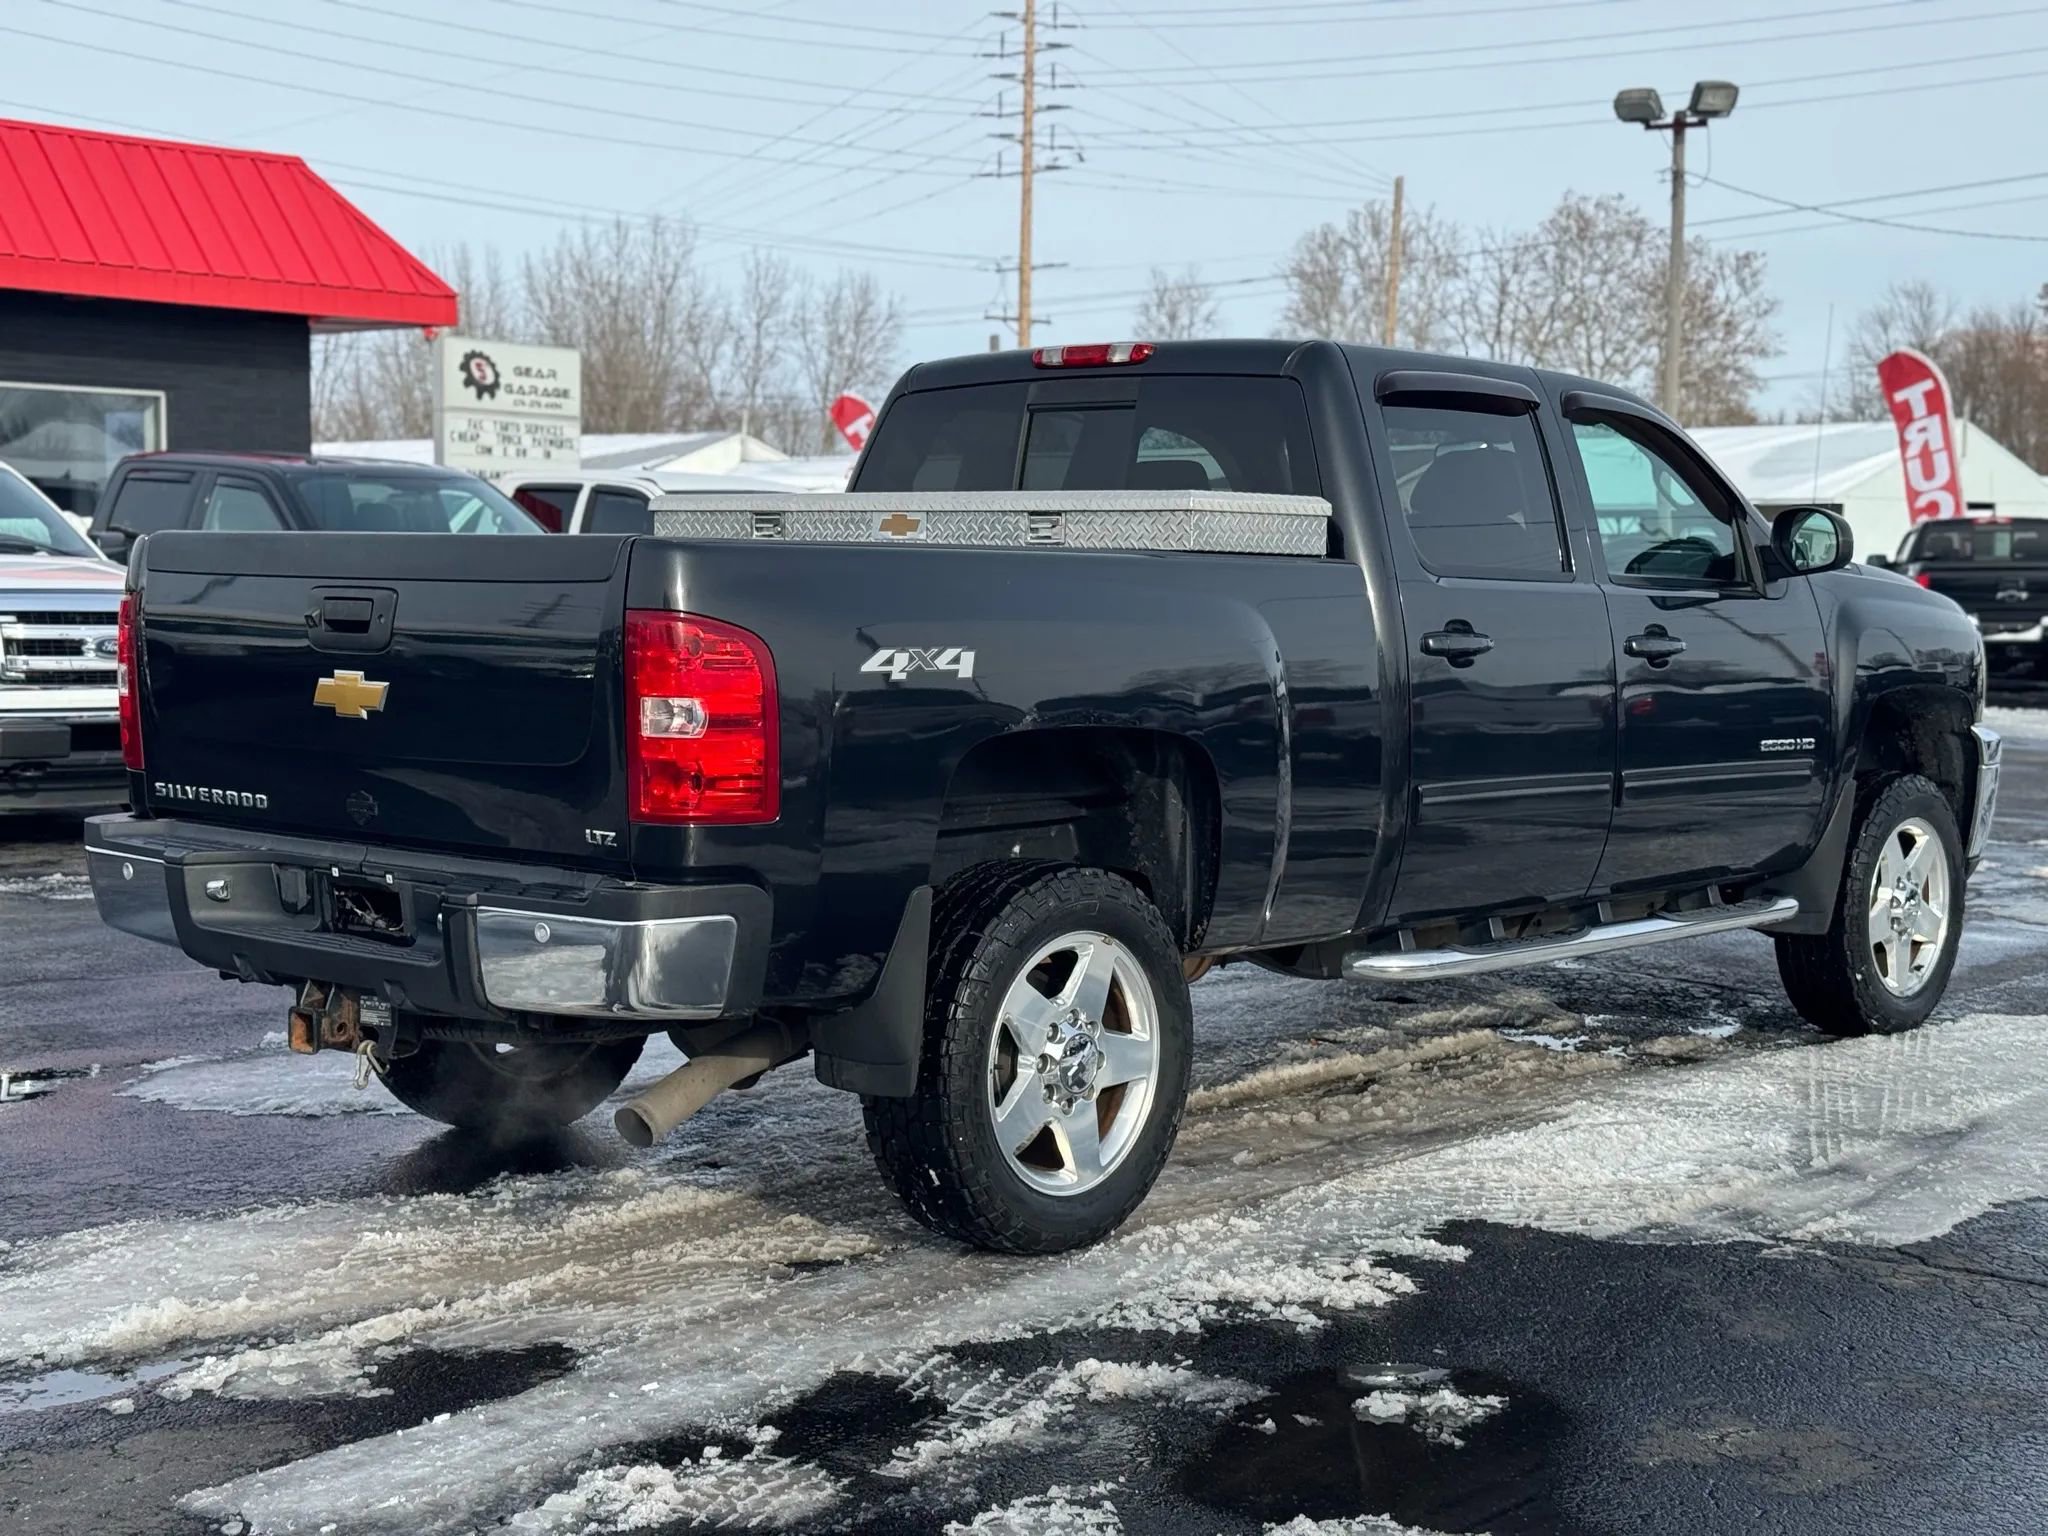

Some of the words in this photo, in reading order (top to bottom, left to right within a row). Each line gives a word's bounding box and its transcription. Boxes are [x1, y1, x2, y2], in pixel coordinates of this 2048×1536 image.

[512, 366, 557, 381] GEAR
[504, 383, 571, 399] GARAGE
[154, 782, 268, 809] SILVERADO
[585, 829, 617, 847] LTZ
